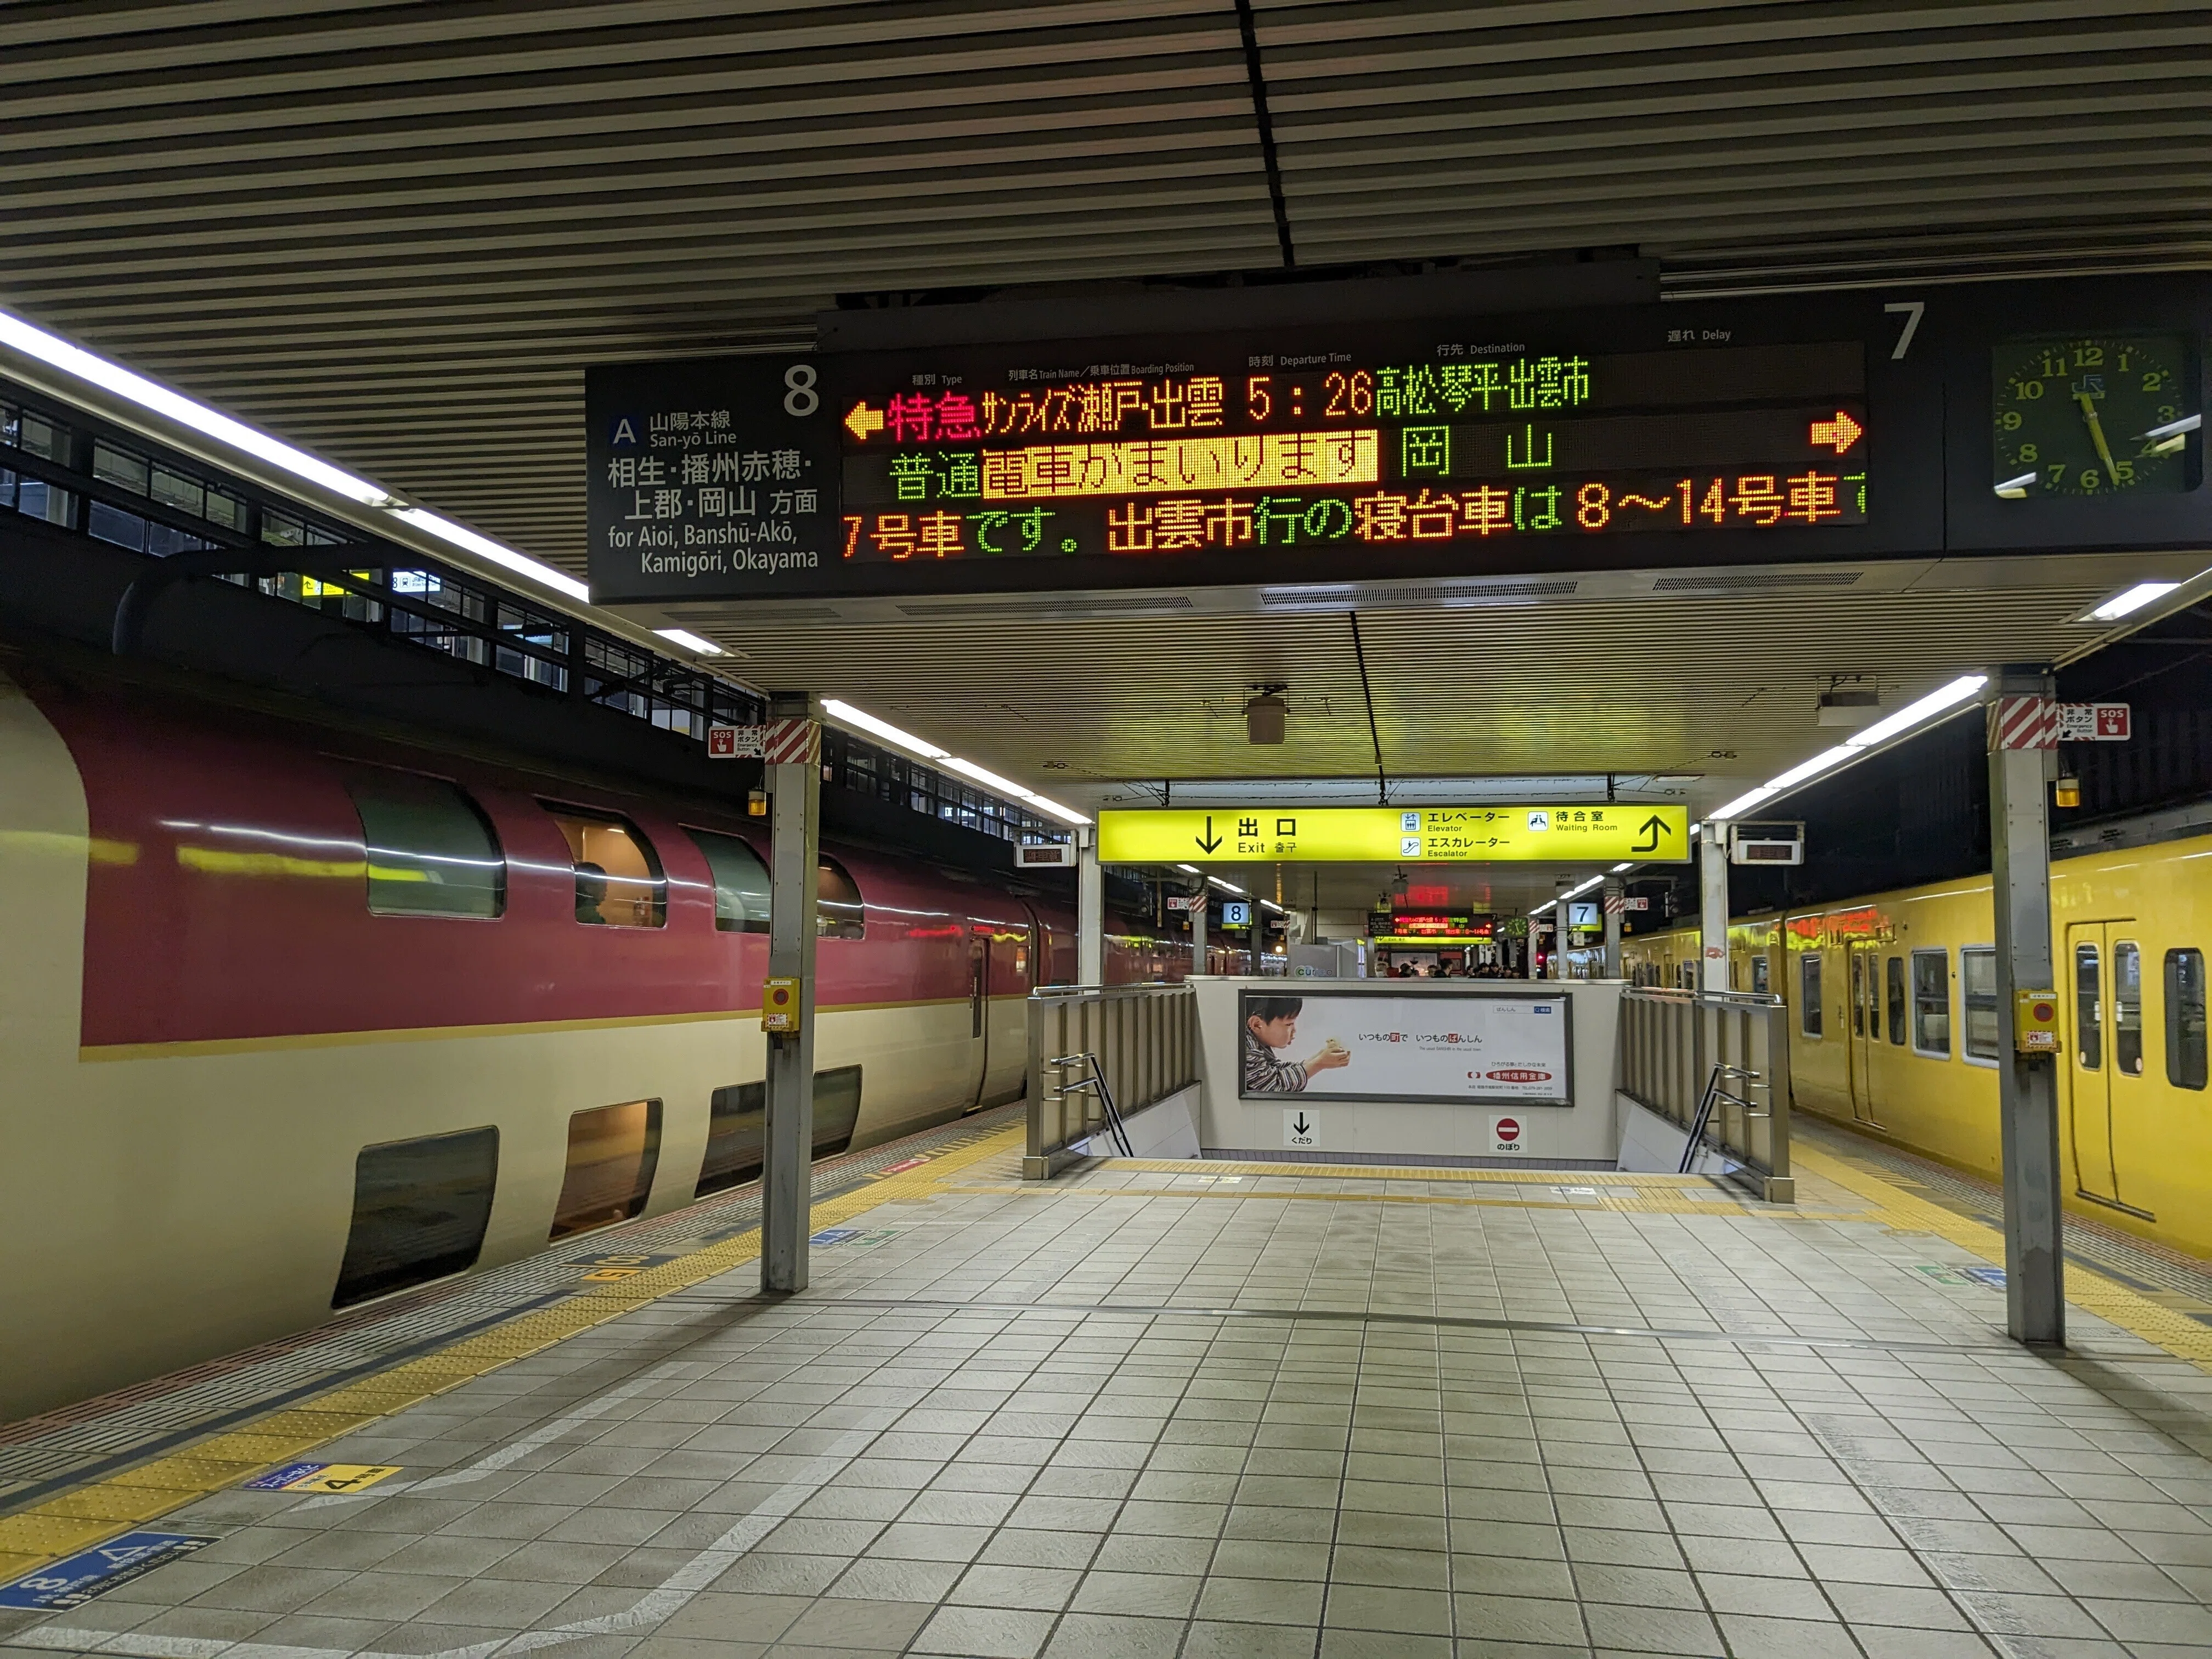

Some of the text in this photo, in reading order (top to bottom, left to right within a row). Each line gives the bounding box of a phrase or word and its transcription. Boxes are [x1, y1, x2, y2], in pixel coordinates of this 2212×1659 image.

[1668, 329, 1731, 342] 遅れ Delay
[1884, 301, 1925, 360] 7
[1437, 341, 1526, 356] 行先 Destination
[2074, 347, 2103, 366] 12
[1249, 353, 1352, 368] 時刻 Departure Time
[2042, 354, 2129, 377] 11 1
[1131, 365, 1163, 376] Boarding
[1165, 363, 1194, 375] Position
[912, 374, 936, 386] 種別
[941, 374, 963, 386] Type
[2016, 373, 2161, 400] 10 2
[783, 364, 820, 417] 8
[649, 411, 731, 432] 山陽本線
[888, 391, 981, 441] 特急
[2003, 405, 2175, 431] 9 3
[613, 418, 636, 444] A
[650, 431, 737, 449] San-yō Line
[2019, 444, 2038, 462] 8
[890, 452, 981, 500] 普通
[983, 430, 1378, 499] 電車がまいります
[2048, 461, 2134, 488] 7 6 5
[624, 486, 817, 520] 上郡・岡山 方面
[608, 527, 634, 548] for
[638, 525, 679, 549] Aioi,
[641, 548, 819, 578] Kamigōri, Okayama
[2101, 709, 2124, 718] SOS
[1427, 811, 1605, 822] エレベーター 待合室
[1238, 817, 1296, 837] 出口
[1556, 824, 1587, 832] Waiting
[1238, 842, 1297, 853] Exit 출구
[1427, 837, 1510, 848] エスカレーター
[1231, 905, 1242, 921] 8
[1576, 907, 1589, 922] 7
[1358, 1032, 1482, 1043] いつもの町で いつものばんしん
[1493, 1072, 1545, 1080] 播州信用金庫
[1291, 1136, 1312, 1145] くだり
[1497, 1143, 1520, 1151] のぼり
[19, 1577, 68, 1590] 8
